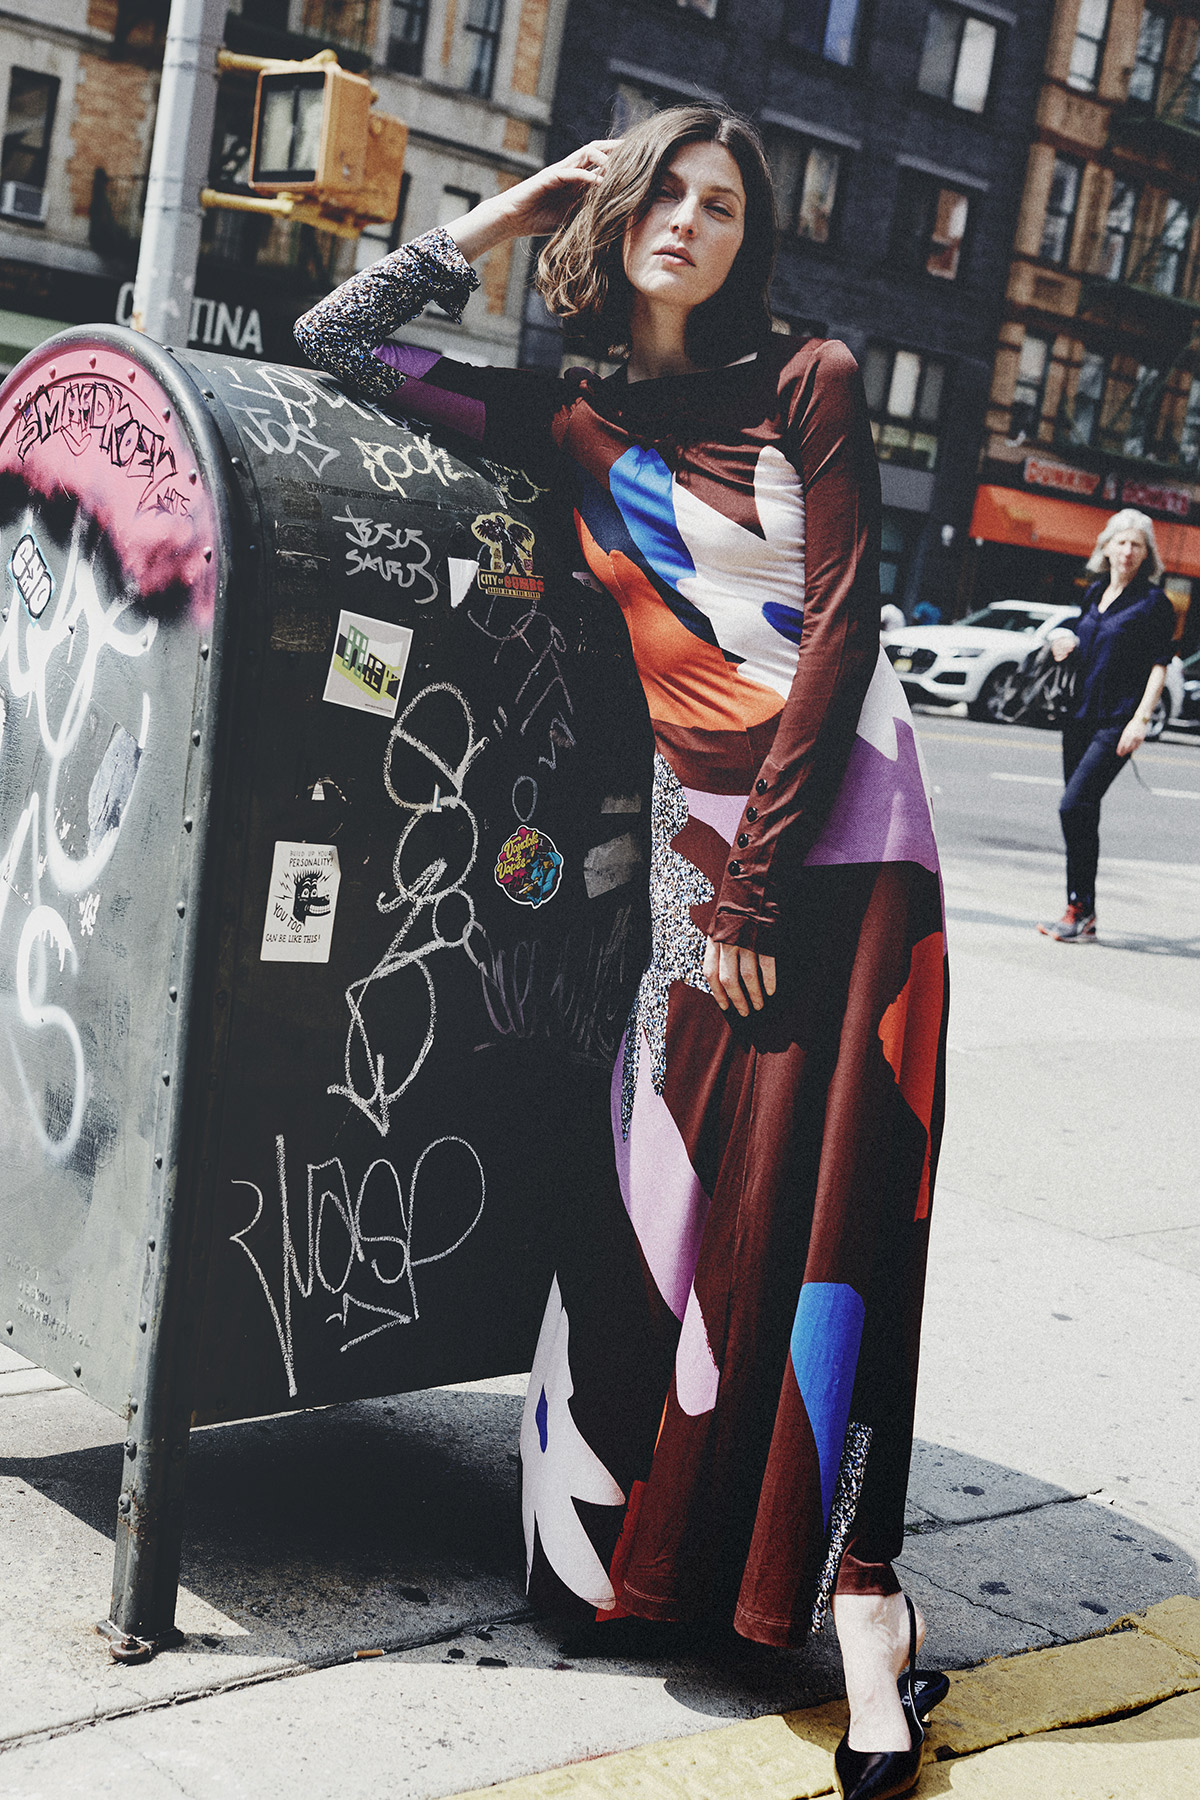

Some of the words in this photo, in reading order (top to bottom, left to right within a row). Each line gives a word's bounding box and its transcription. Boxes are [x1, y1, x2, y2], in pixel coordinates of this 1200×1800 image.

[115, 281, 263, 354] CTINA
[480, 573, 497, 585] CITY
[504, 830, 539, 859] Vandals
[496, 857, 526, 880] Vapes
[272, 902, 288, 922] YOU
[286, 916, 302, 933] TOO
[265, 933, 277, 943] CAN
[278, 934, 286, 943] BE
[288, 934, 302, 944] LIKE
[303, 934, 321, 944] THIS!
